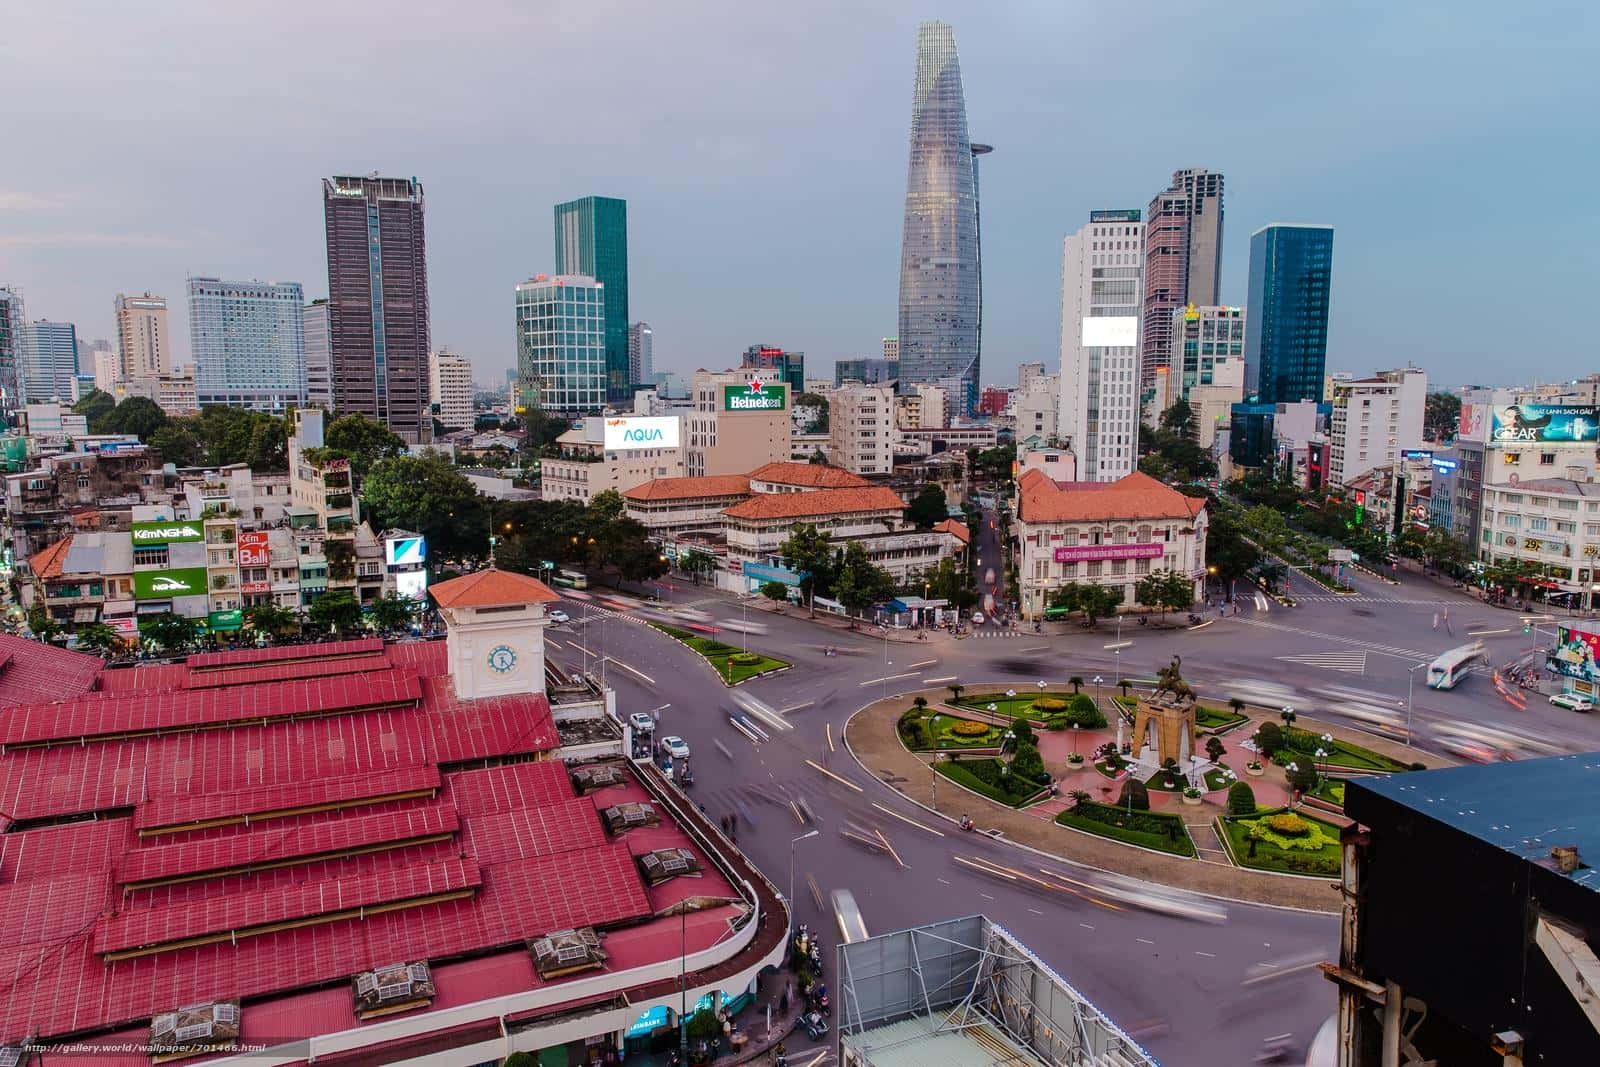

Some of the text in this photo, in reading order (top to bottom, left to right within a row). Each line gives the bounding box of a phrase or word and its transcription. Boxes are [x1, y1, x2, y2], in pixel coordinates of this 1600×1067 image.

[730, 396, 781, 409] Heineken
[624, 429, 663, 441] AQUA
[1494, 428, 1536, 439] CEAR
